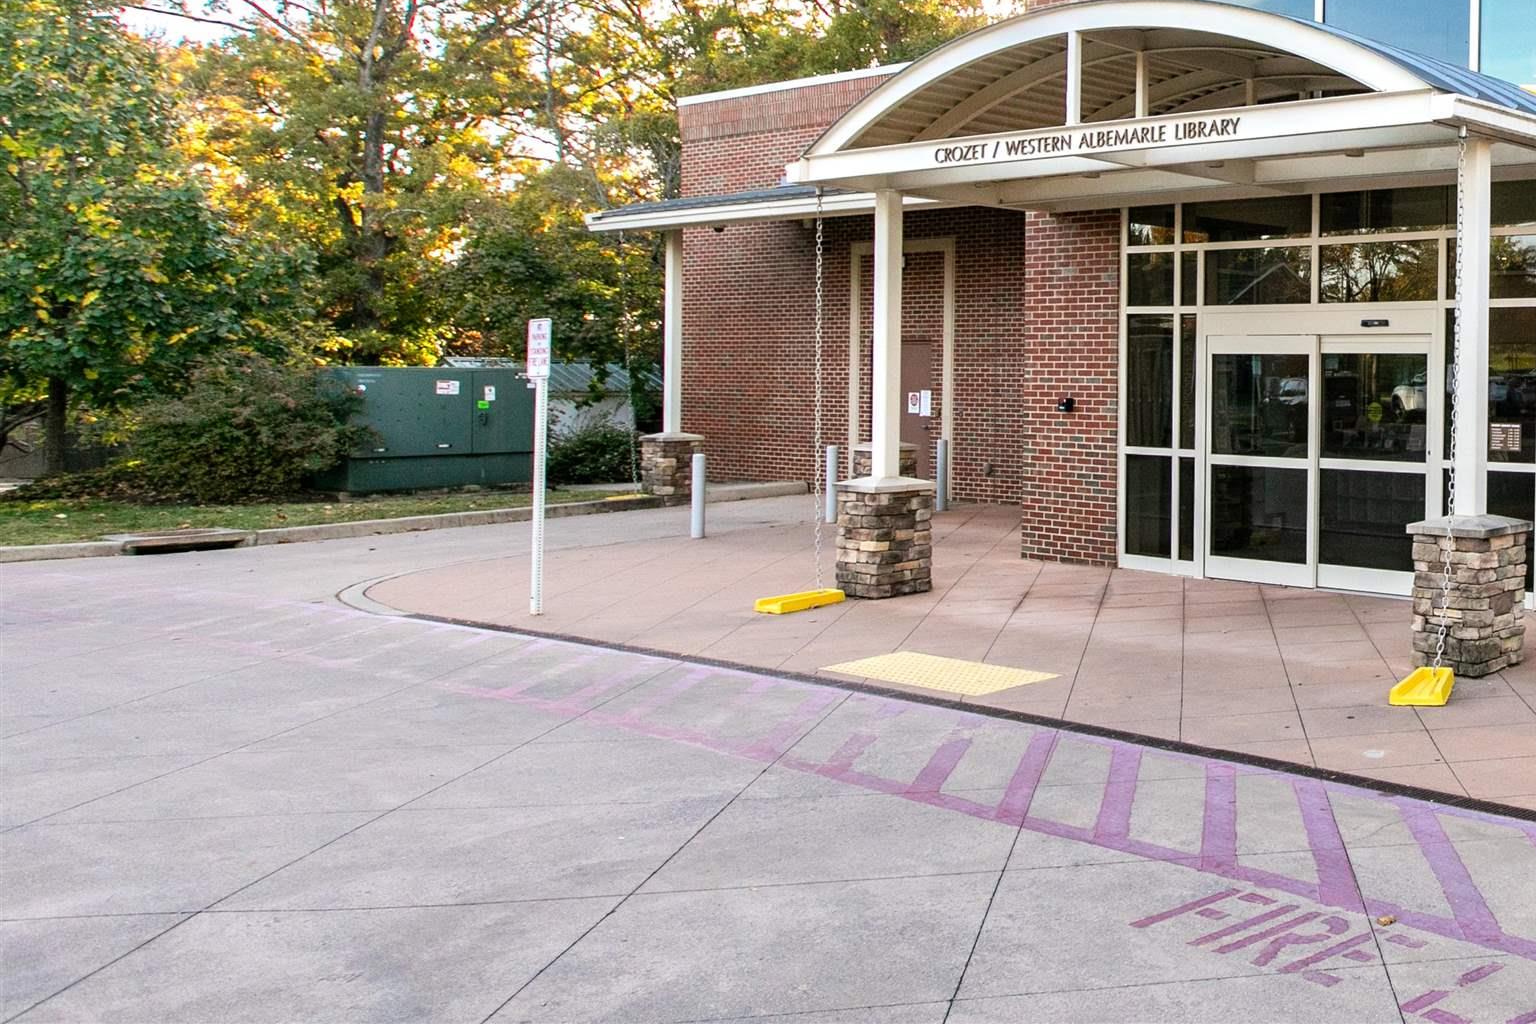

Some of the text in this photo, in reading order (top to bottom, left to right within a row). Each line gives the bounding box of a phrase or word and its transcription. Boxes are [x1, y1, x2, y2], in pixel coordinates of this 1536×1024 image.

[934, 117, 1241, 164] CROZET / WESTERN ALBEMARLE LIBRARY
[1128, 887, 1428, 988] FIRE
